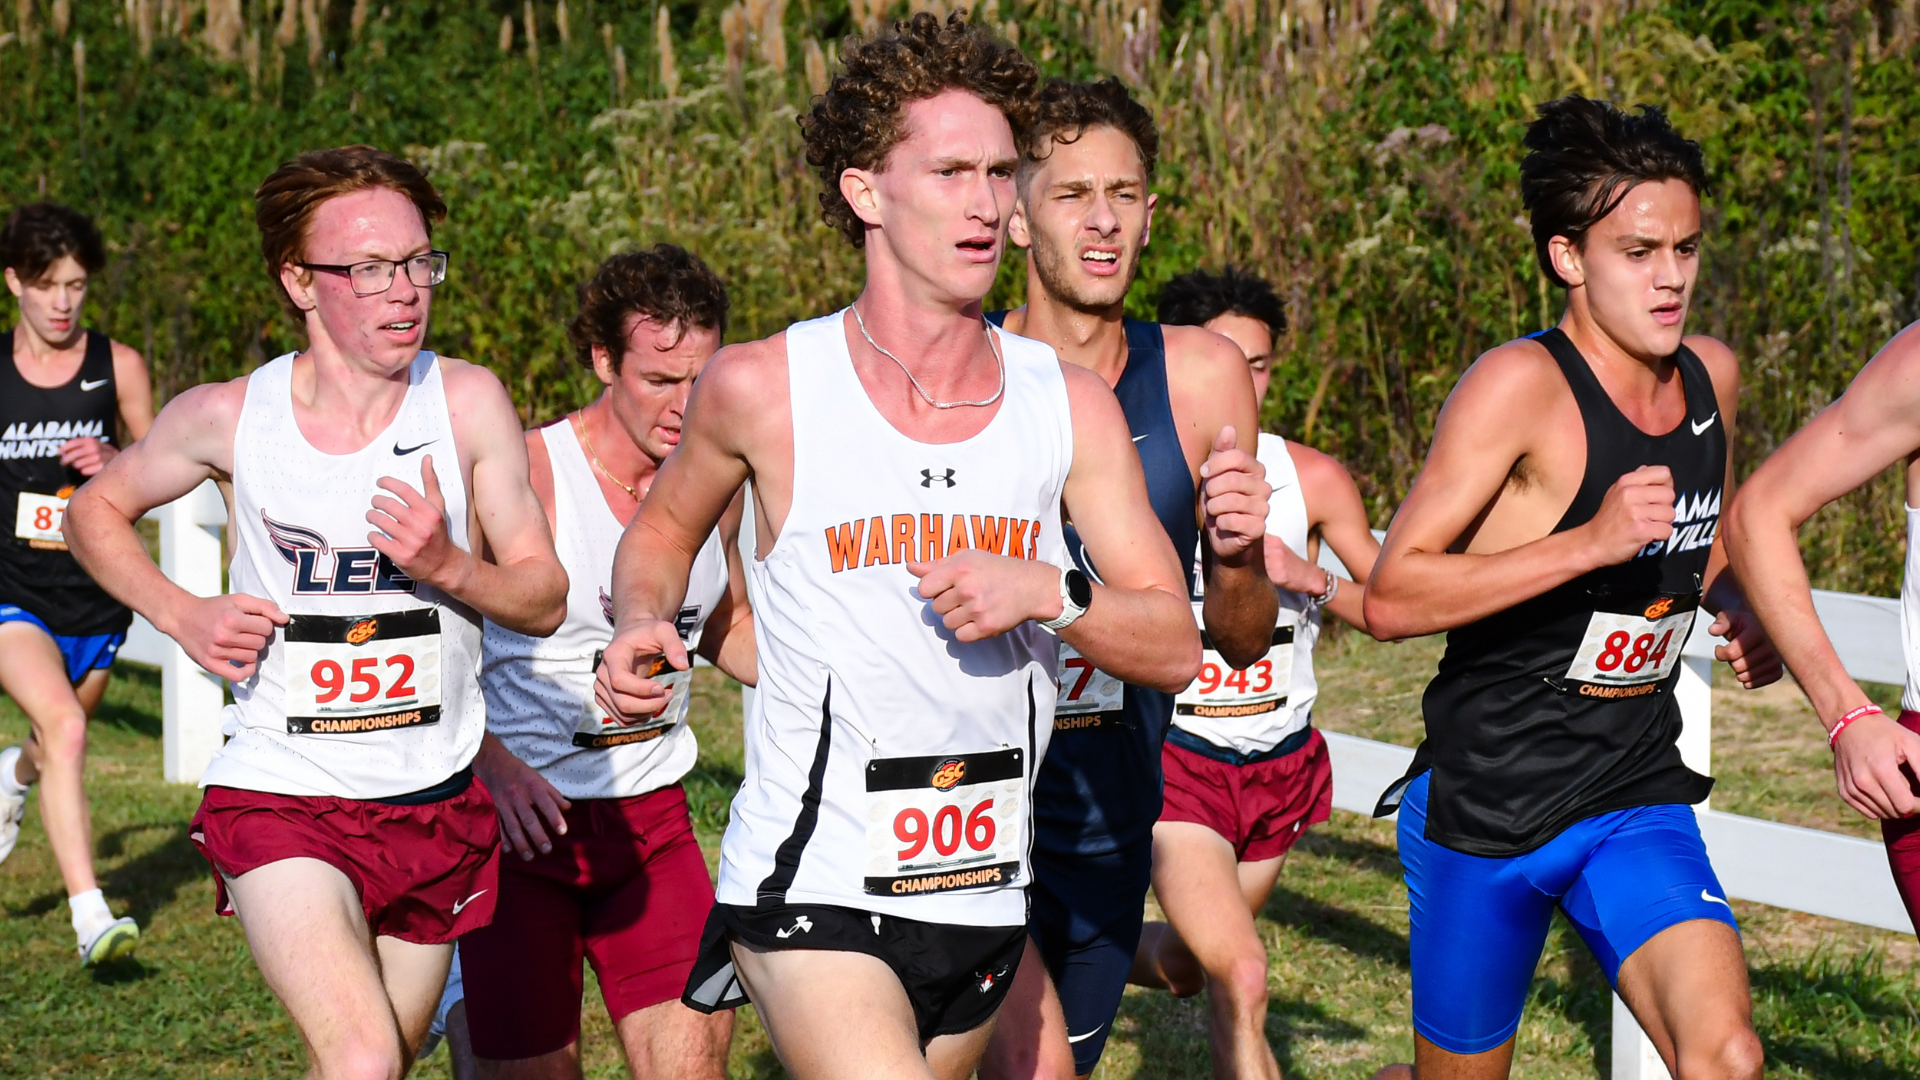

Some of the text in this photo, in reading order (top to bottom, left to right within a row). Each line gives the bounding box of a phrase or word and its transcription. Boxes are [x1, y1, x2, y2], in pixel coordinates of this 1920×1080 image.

[1, 419, 103, 441] ALABAMA
[1670, 486, 1722, 523] AMA
[825, 513, 1041, 574] WARHAWKS
[292, 546, 418, 595] LEE
[1644, 598, 1674, 620] GSC
[346, 619, 378, 644] GSC
[1595, 628, 1675, 674] 884
[310, 653, 416, 704] 952
[1199, 659, 1274, 695] 943
[1578, 682, 1657, 699] CHAMPIONSHIPS
[310, 710, 422, 733] CHAMPIONSHIPS
[1193, 700, 1277, 717] CHAMPIONSHIPS
[592, 727, 663, 748] CHAMPIONSHIPS
[931, 760, 967, 789] GSC
[893, 798, 997, 862] 906
[891, 867, 1002, 894] CHAMPIONSHIPS
